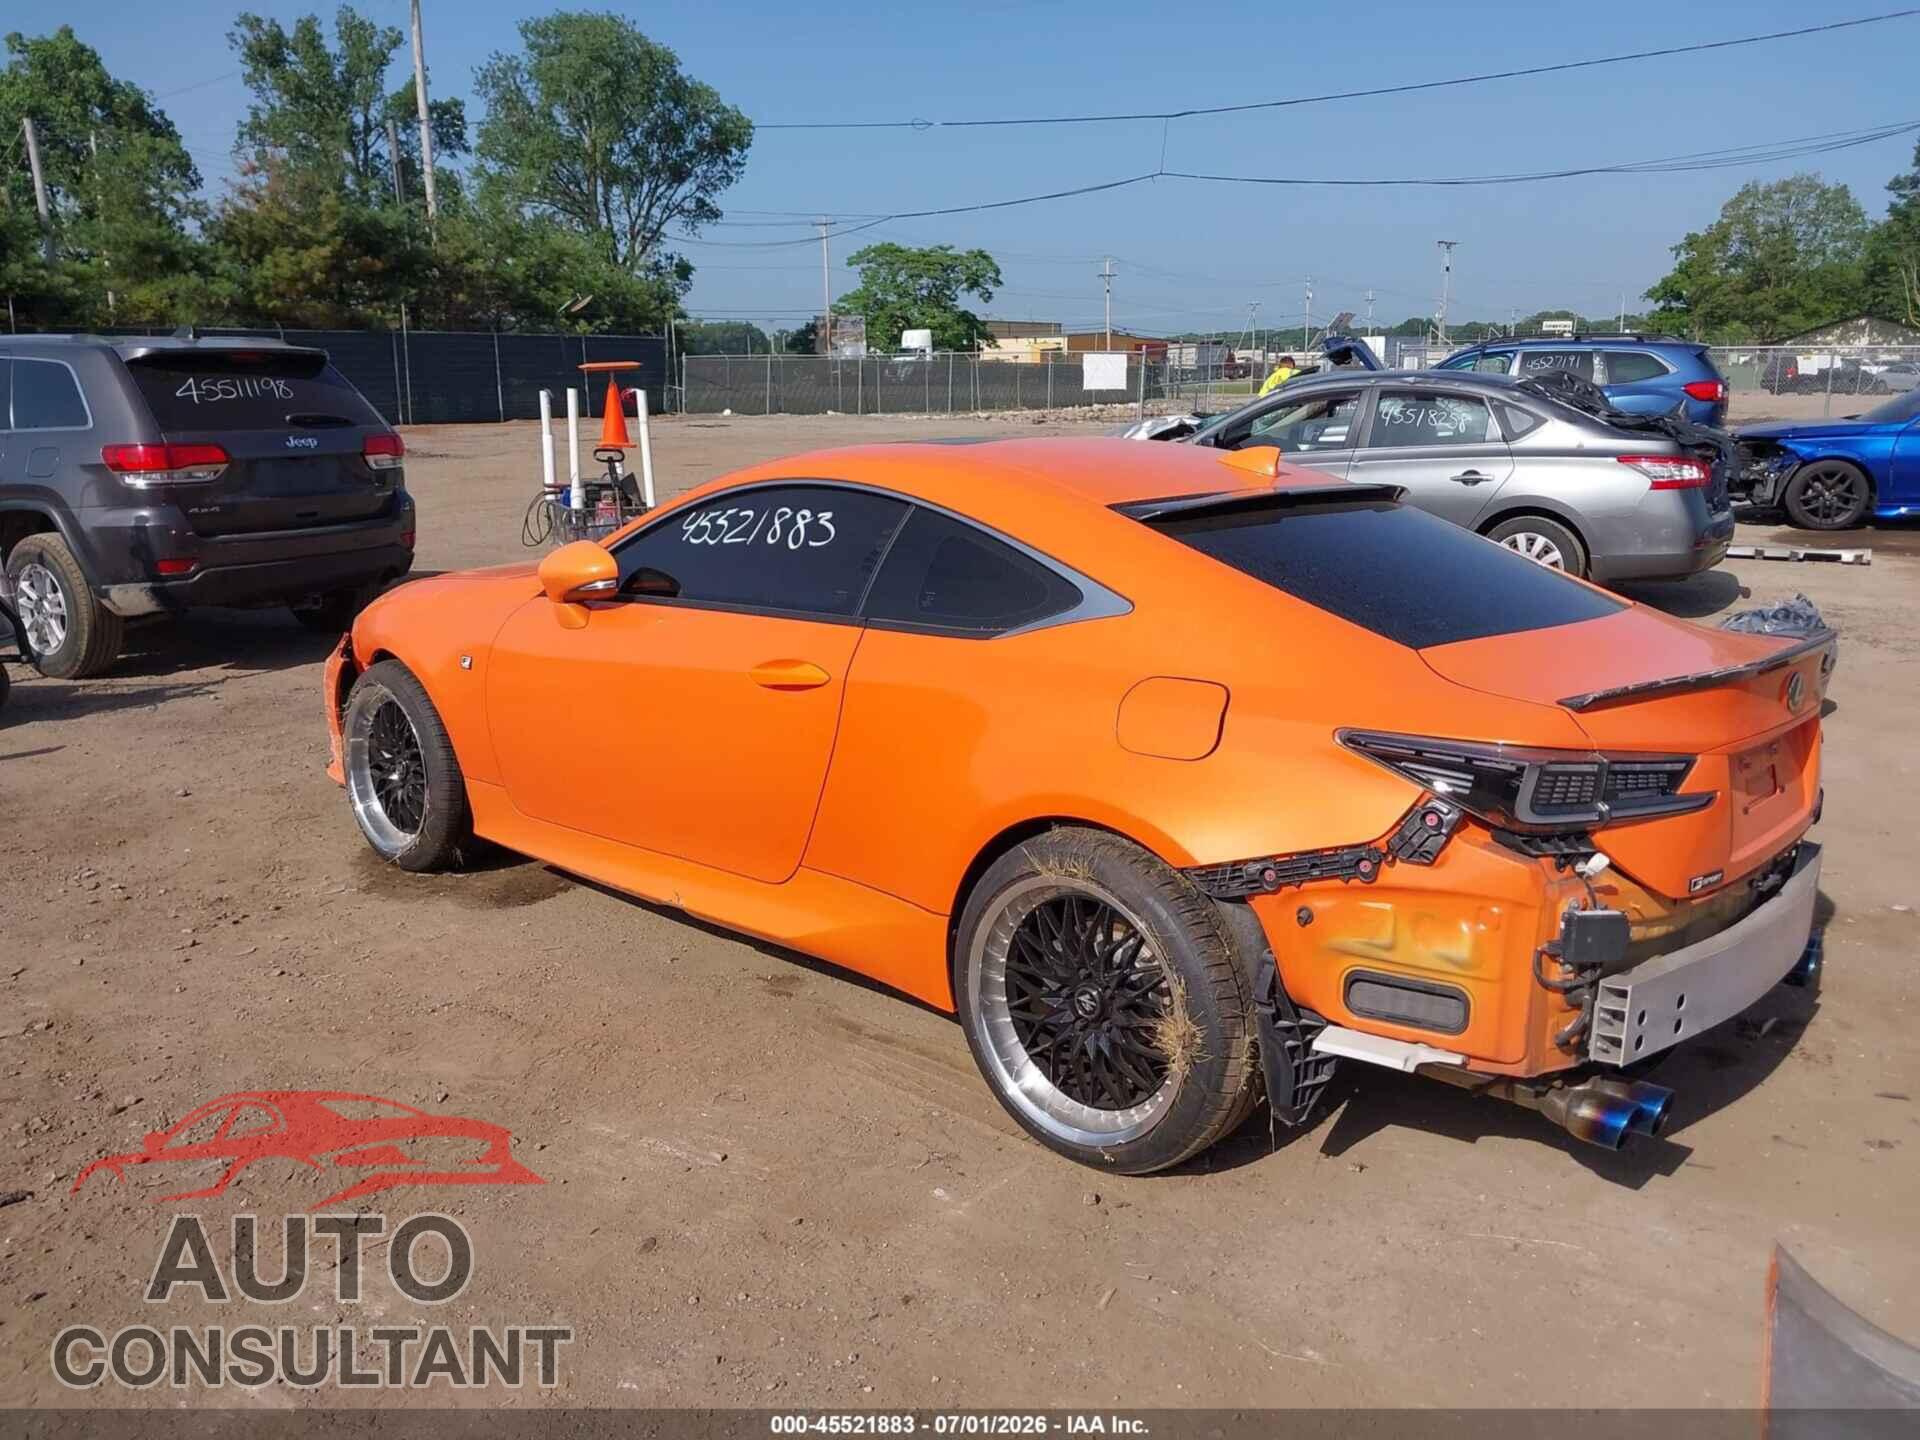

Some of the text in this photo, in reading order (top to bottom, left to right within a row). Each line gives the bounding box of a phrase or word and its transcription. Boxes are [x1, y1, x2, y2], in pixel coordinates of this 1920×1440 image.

[1526, 355, 1581, 370] 45527191
[176, 377, 294, 404] 45511198
[285, 435, 318, 449] Jeep
[681, 507, 836, 551] 45521883
